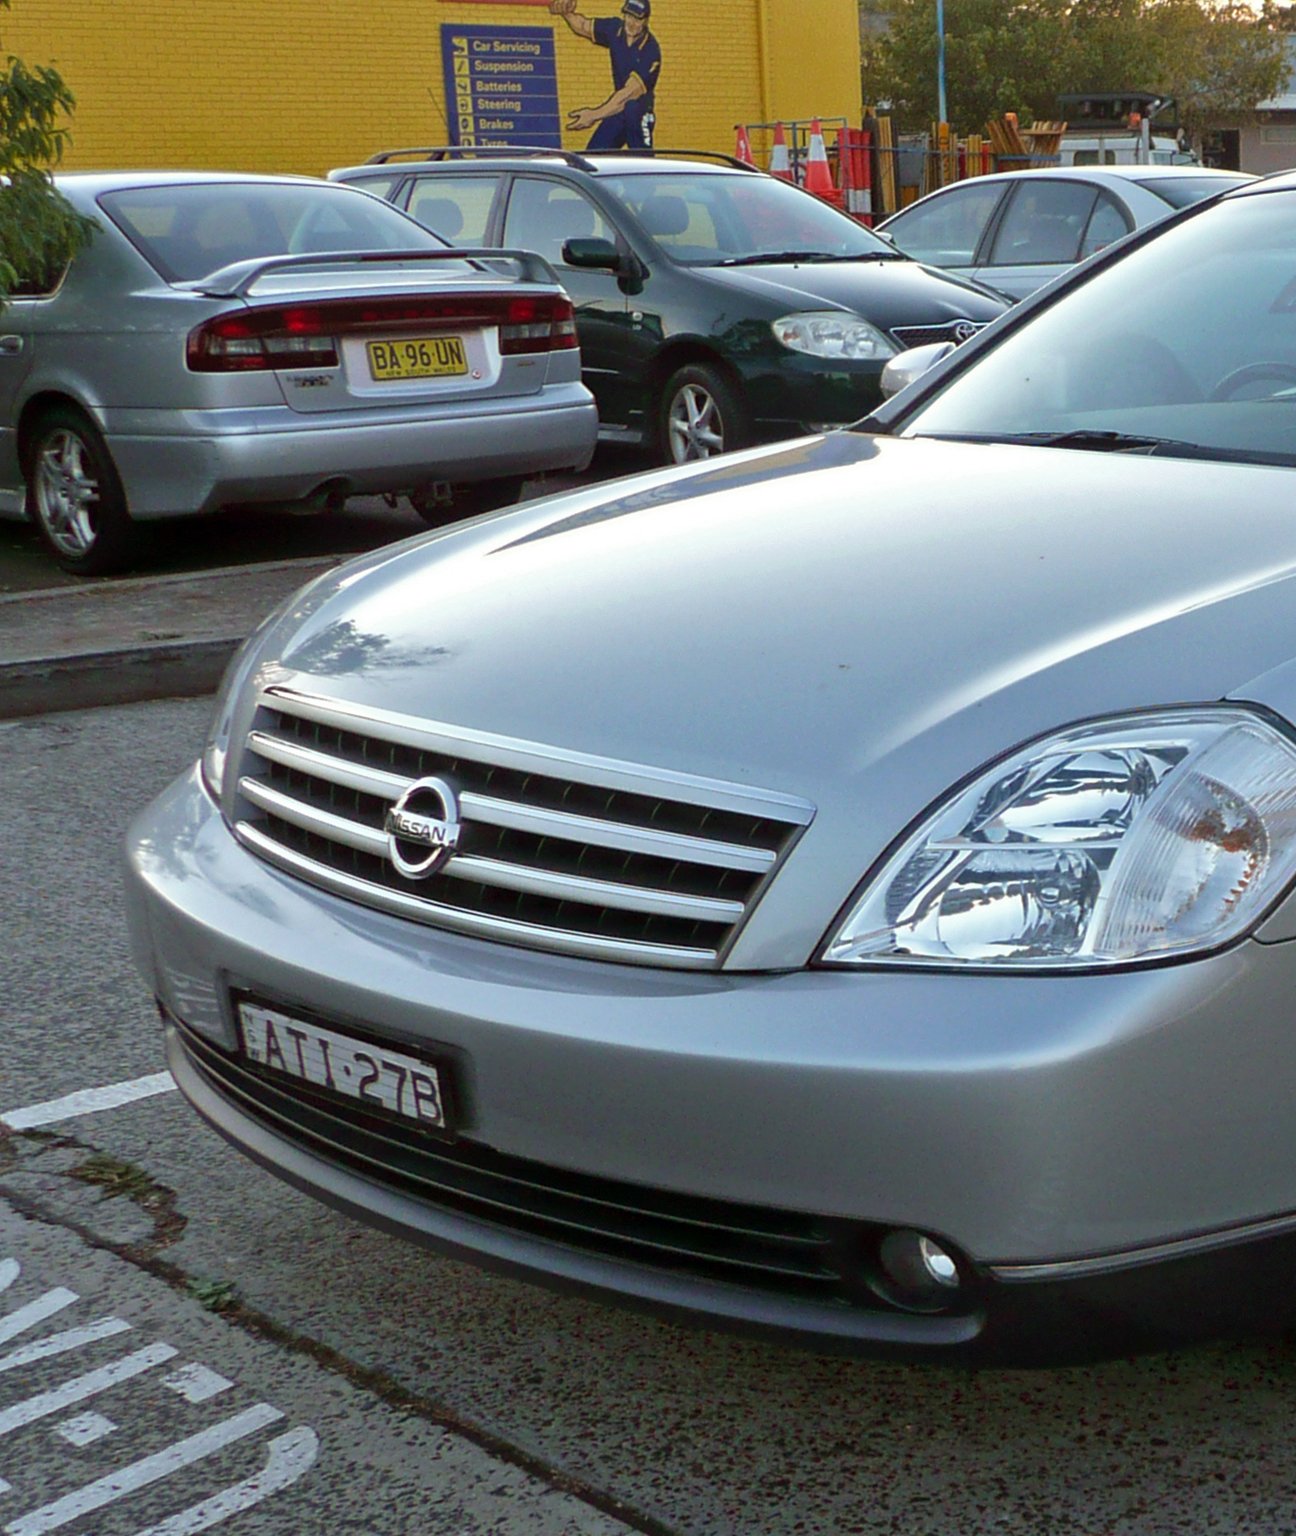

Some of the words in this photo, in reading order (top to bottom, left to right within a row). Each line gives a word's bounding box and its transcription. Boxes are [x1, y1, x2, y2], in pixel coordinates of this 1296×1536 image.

[473, 40, 491, 52] Car
[493, 41, 541, 55] Servicing
[474, 60, 534, 73] Suspension
[476, 81, 522, 92] Batteries
[477, 98, 521, 112] Steering
[479, 118, 514, 130] Brakes
